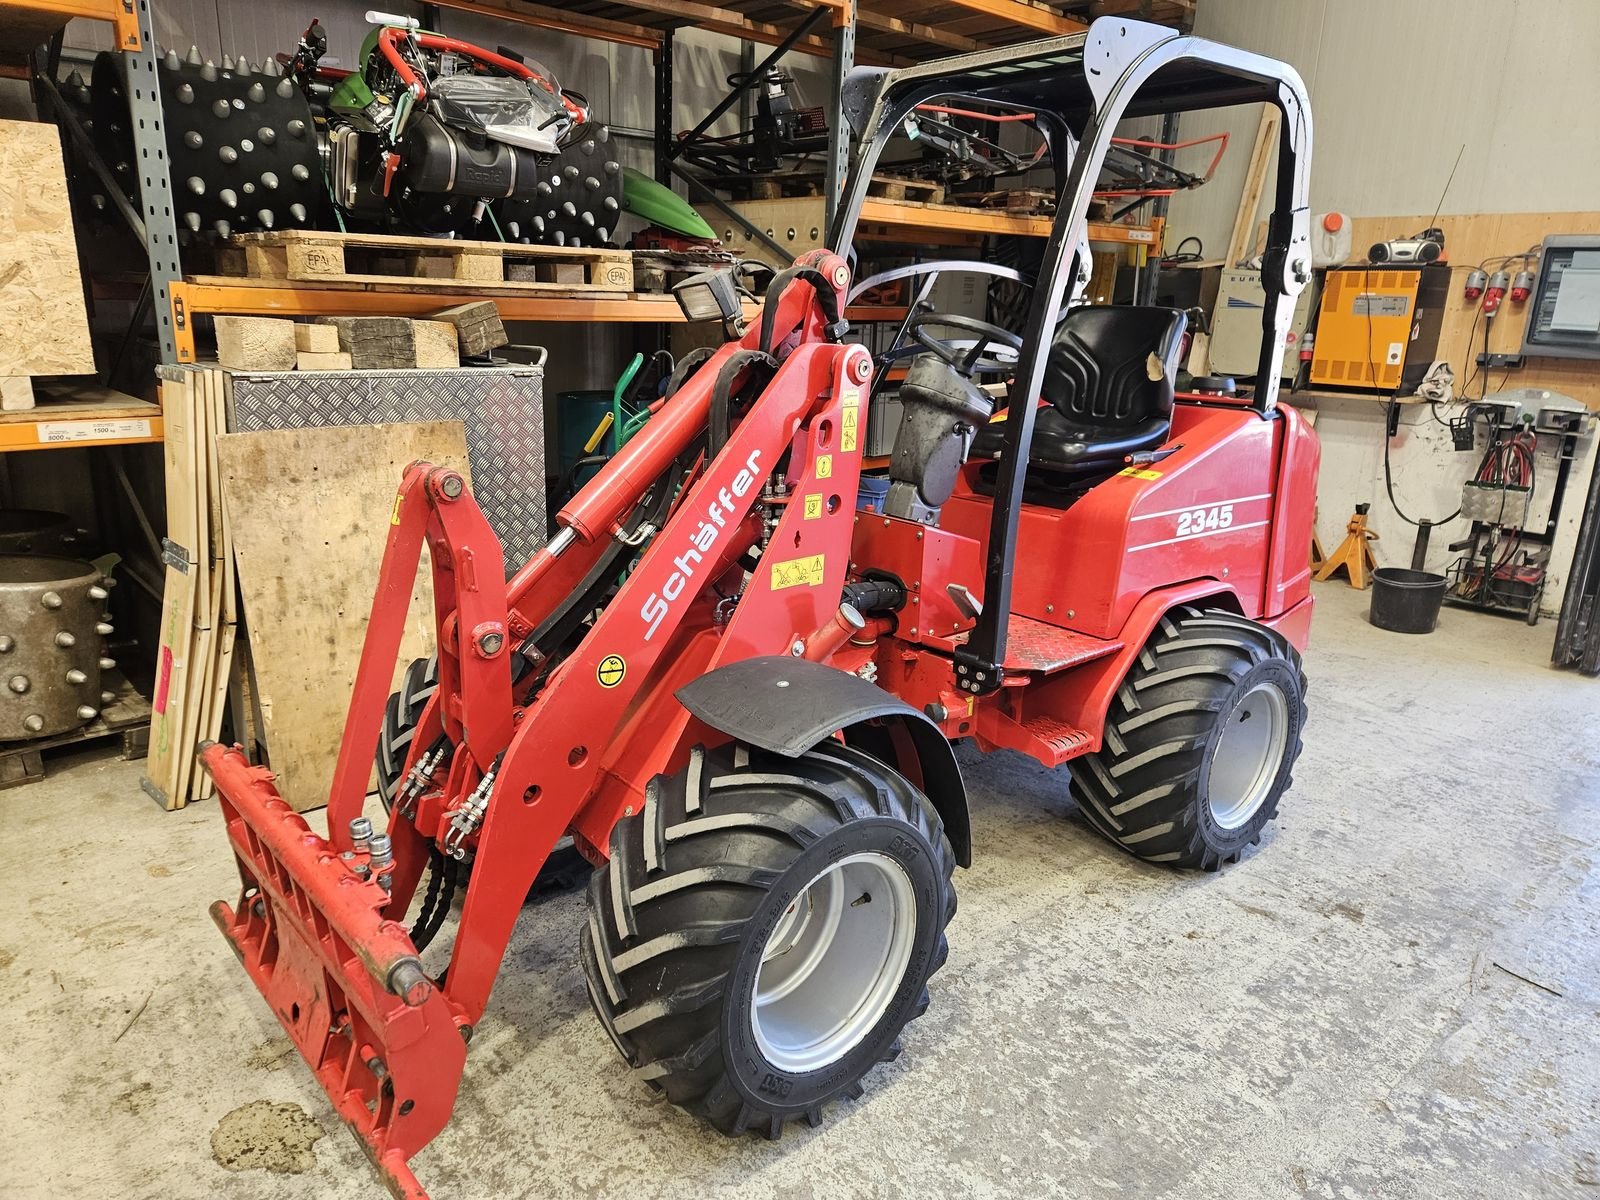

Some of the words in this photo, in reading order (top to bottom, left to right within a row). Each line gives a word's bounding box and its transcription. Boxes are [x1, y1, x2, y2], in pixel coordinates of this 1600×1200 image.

[465, 167, 503, 183] Rapid
[1176, 504, 1233, 537] 2345
[640, 449, 762, 641] Schäffer
[759, 1073, 794, 1098] BKT
